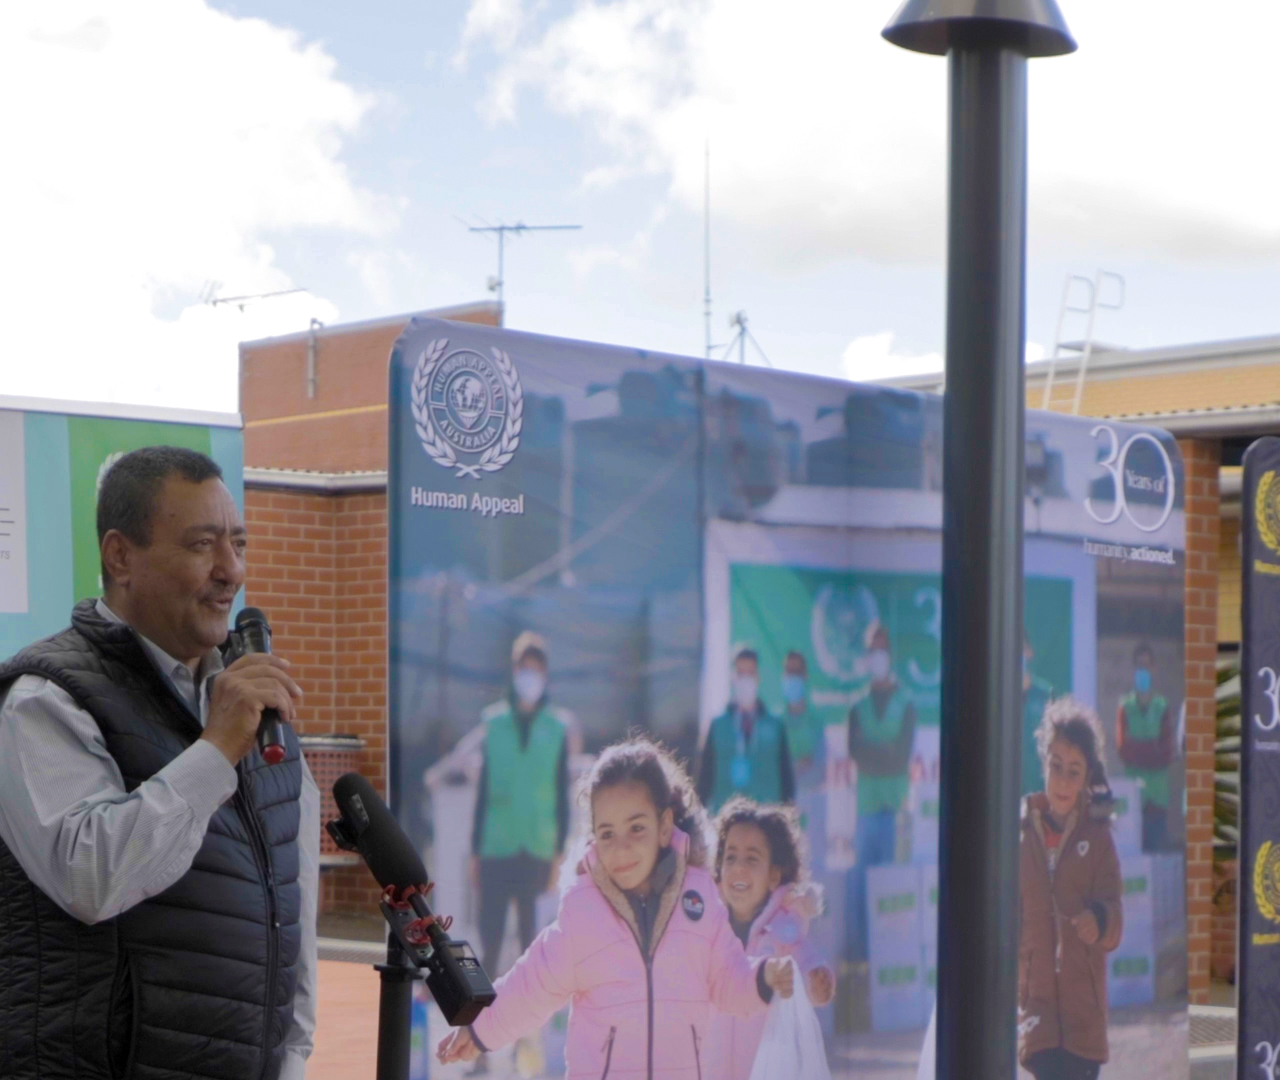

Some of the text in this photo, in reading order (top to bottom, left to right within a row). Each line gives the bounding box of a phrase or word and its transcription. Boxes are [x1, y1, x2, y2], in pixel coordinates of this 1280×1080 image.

[440, 419, 496, 448] AUSTRALIA
[1084, 425, 1175, 532] 30
[411, 486, 524, 517] Human Appeal
